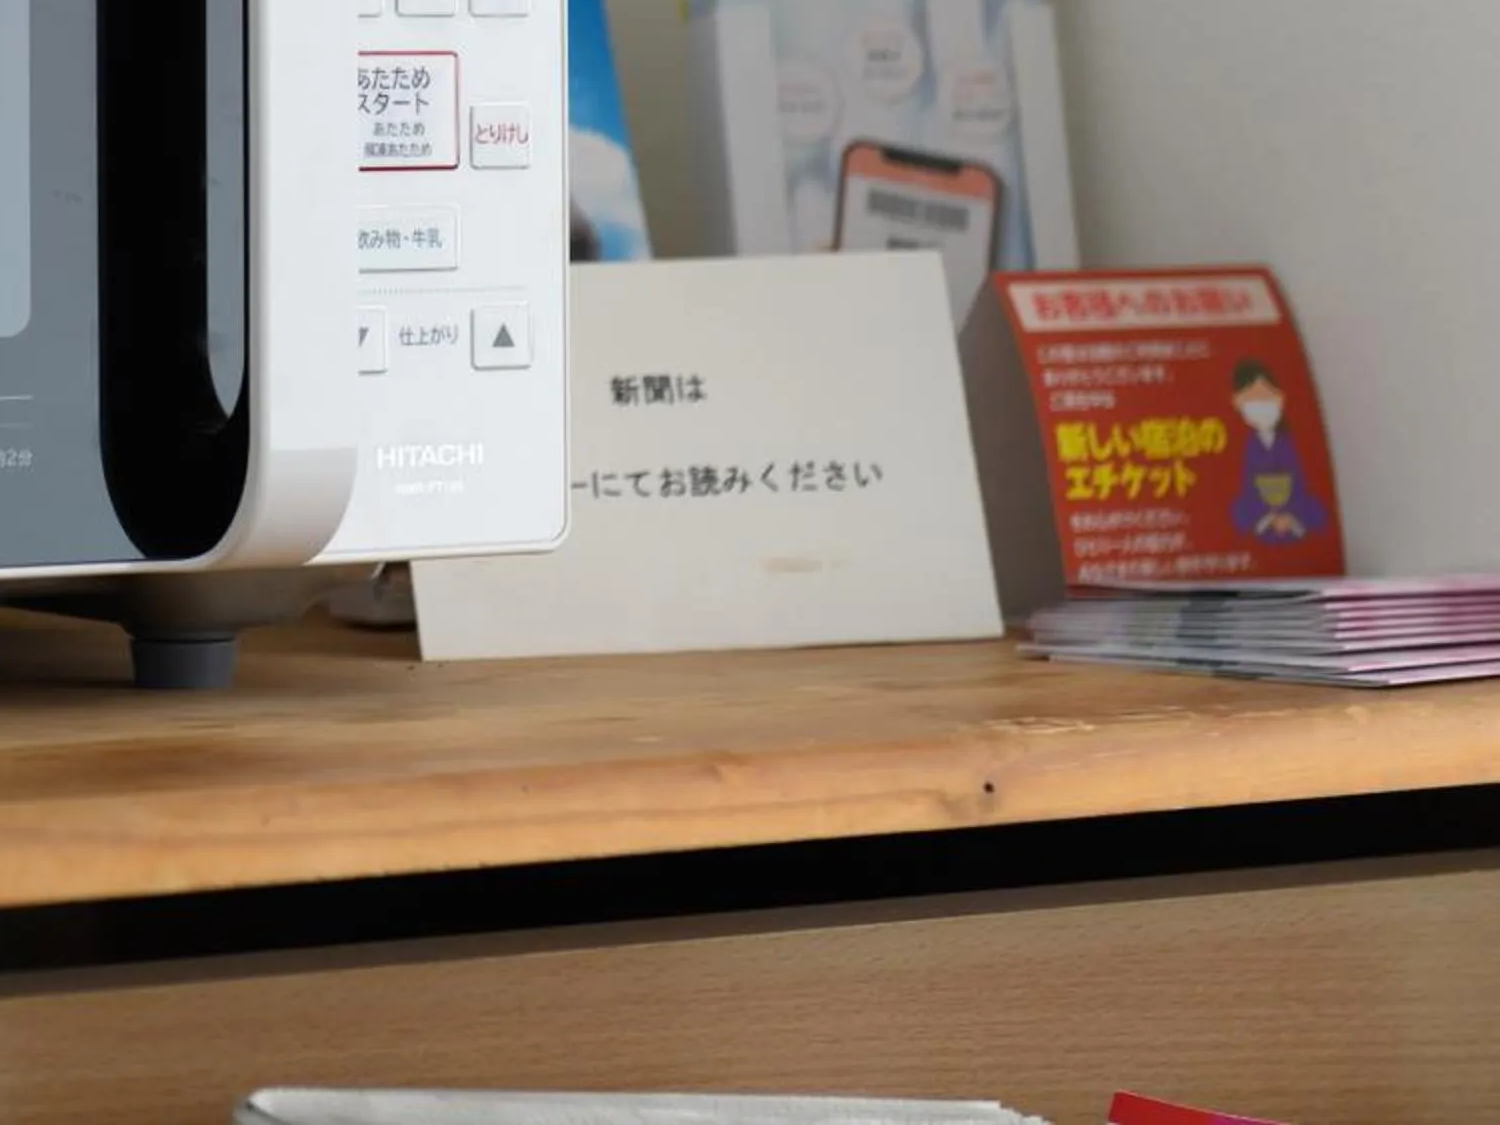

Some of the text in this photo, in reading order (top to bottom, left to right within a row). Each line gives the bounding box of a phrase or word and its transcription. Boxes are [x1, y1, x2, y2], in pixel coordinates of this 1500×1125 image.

[358, 66, 431, 90] あたため
[358, 92, 430, 115] スタート
[474, 124, 529, 145] とりけし
[399, 324, 459, 346] 仕上がり
[610, 373, 707, 405] 新聞は
[376, 442, 484, 470] HITACHI
[1064, 459, 1196, 501] エチケット
